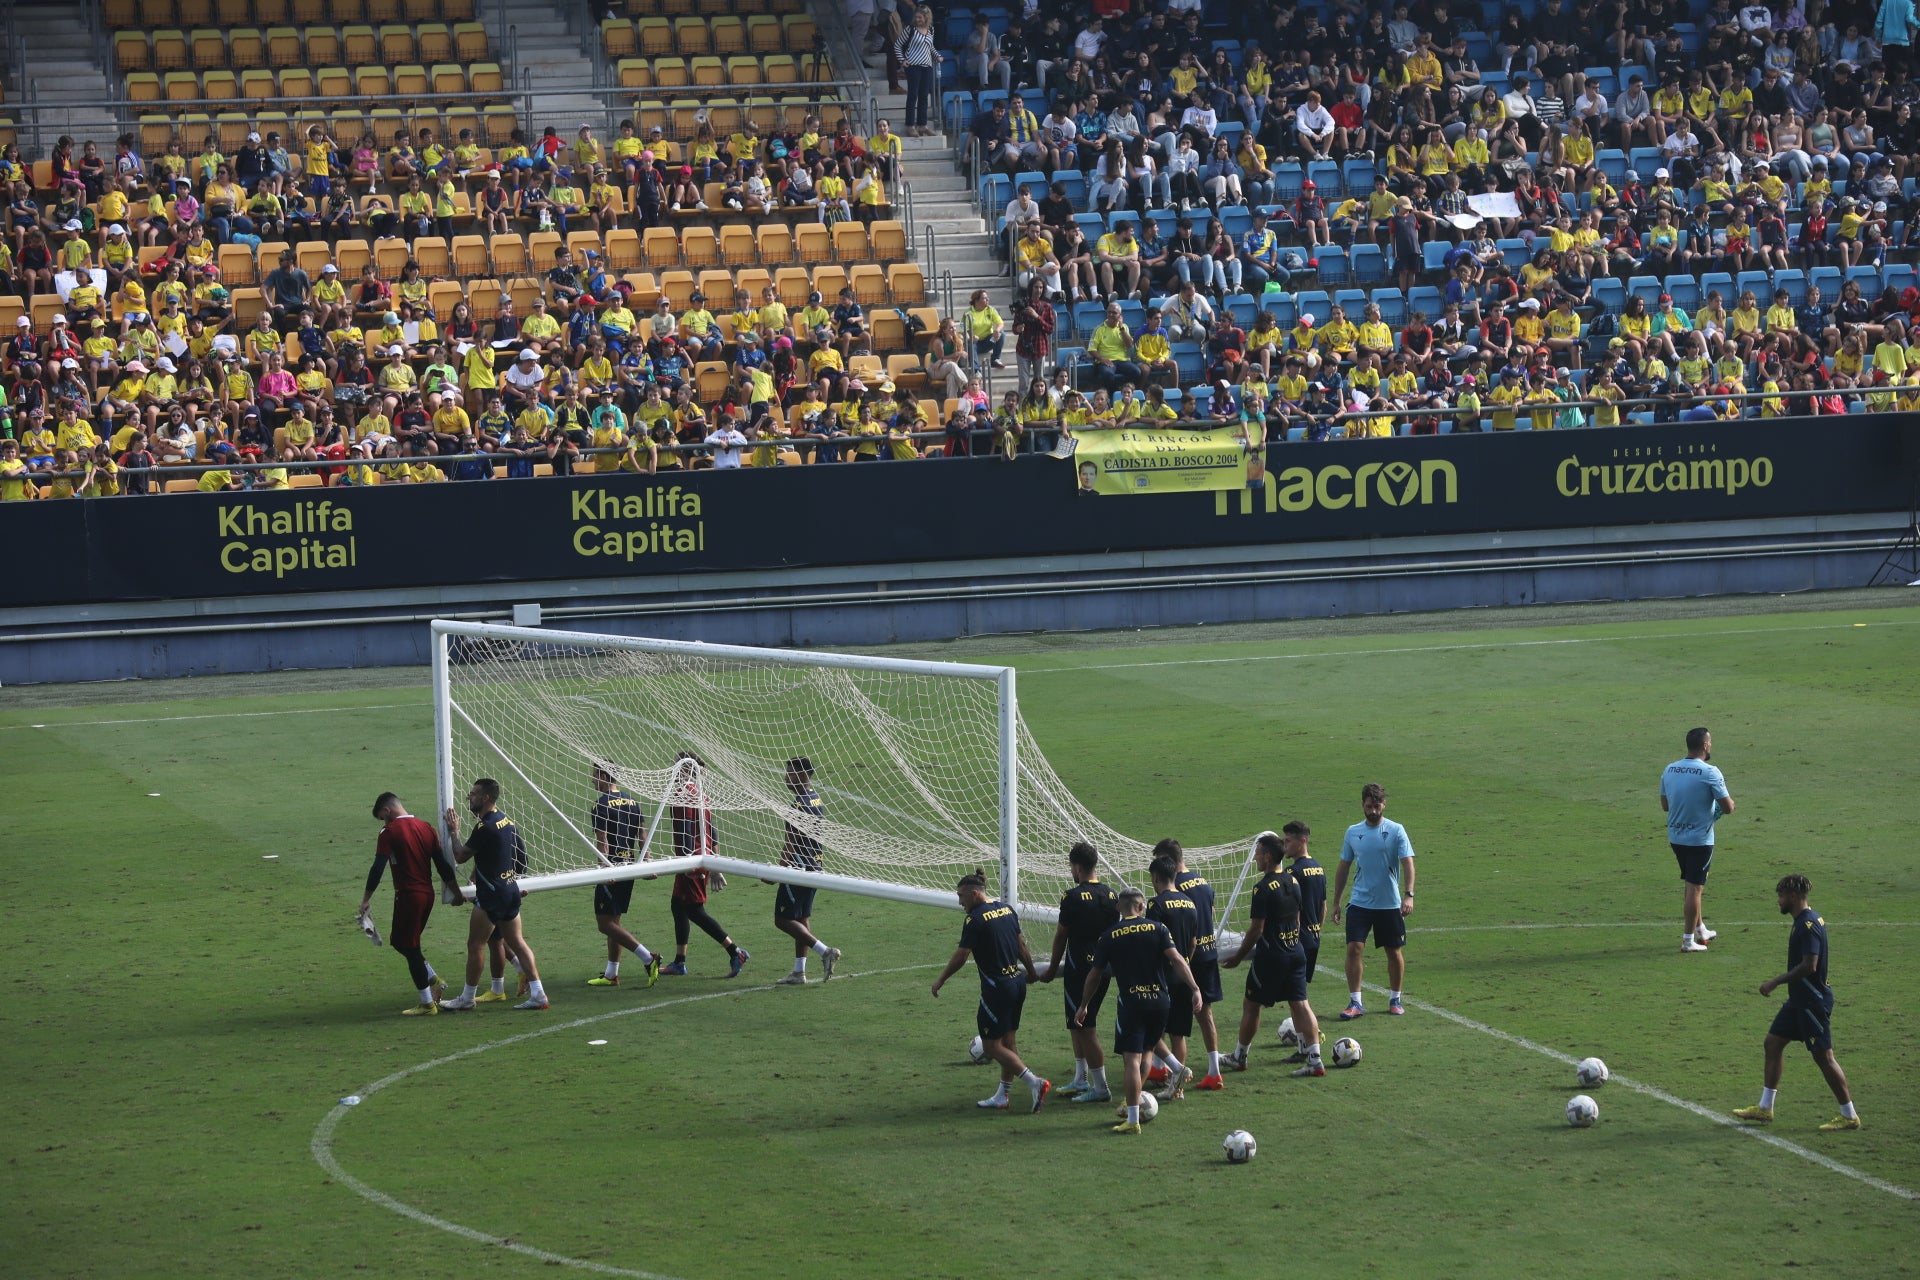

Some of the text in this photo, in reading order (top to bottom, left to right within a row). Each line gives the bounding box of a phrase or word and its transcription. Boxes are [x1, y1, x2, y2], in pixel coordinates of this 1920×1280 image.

[1121, 433, 1212, 443] EL RINCÓN
[1104, 453, 1238, 469] CADISTA D. BOSCO 2004
[1613, 447, 1662, 457] DESDE
[1556, 454, 1774, 497] Cruzcampo
[571, 485, 701, 520] Khalifa
[218, 500, 353, 537] Khalifa
[573, 520, 704, 562] Capital
[220, 535, 356, 578] Capital
[1668, 766, 1703, 776] macron
[1111, 923, 1156, 939] macron
